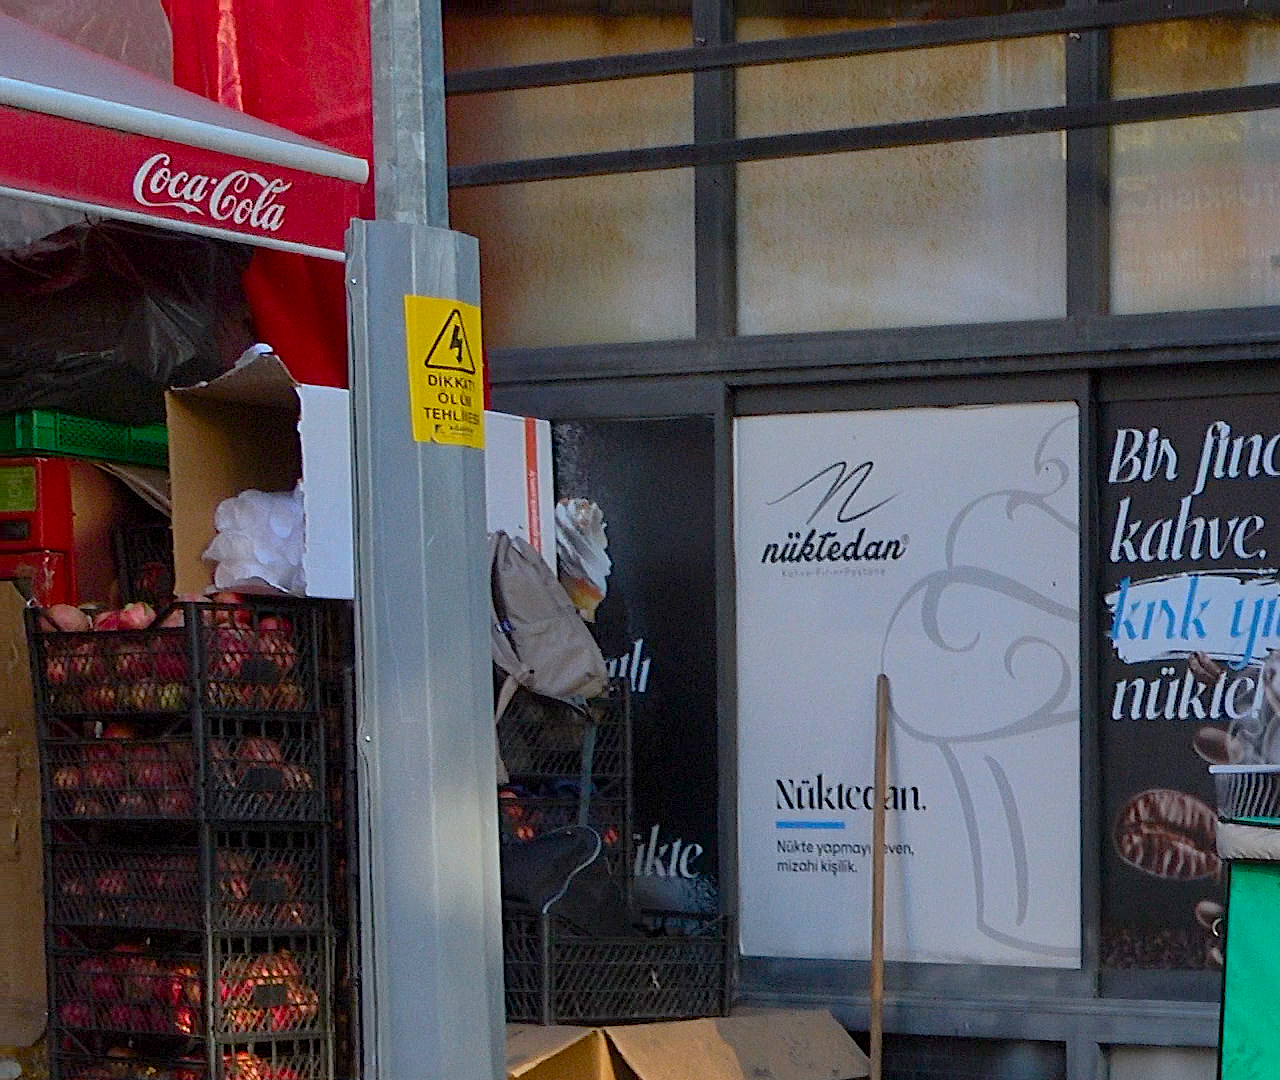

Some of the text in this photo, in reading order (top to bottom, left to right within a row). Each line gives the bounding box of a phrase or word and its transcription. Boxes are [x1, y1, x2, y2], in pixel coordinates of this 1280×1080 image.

[133, 153, 292, 232] Coca-Cola
[1108, 427, 1178, 483] Bir
[776, 839, 814, 854] Nükte
[883, 842, 915, 856] even,
[776, 859, 818, 872] mizahi
